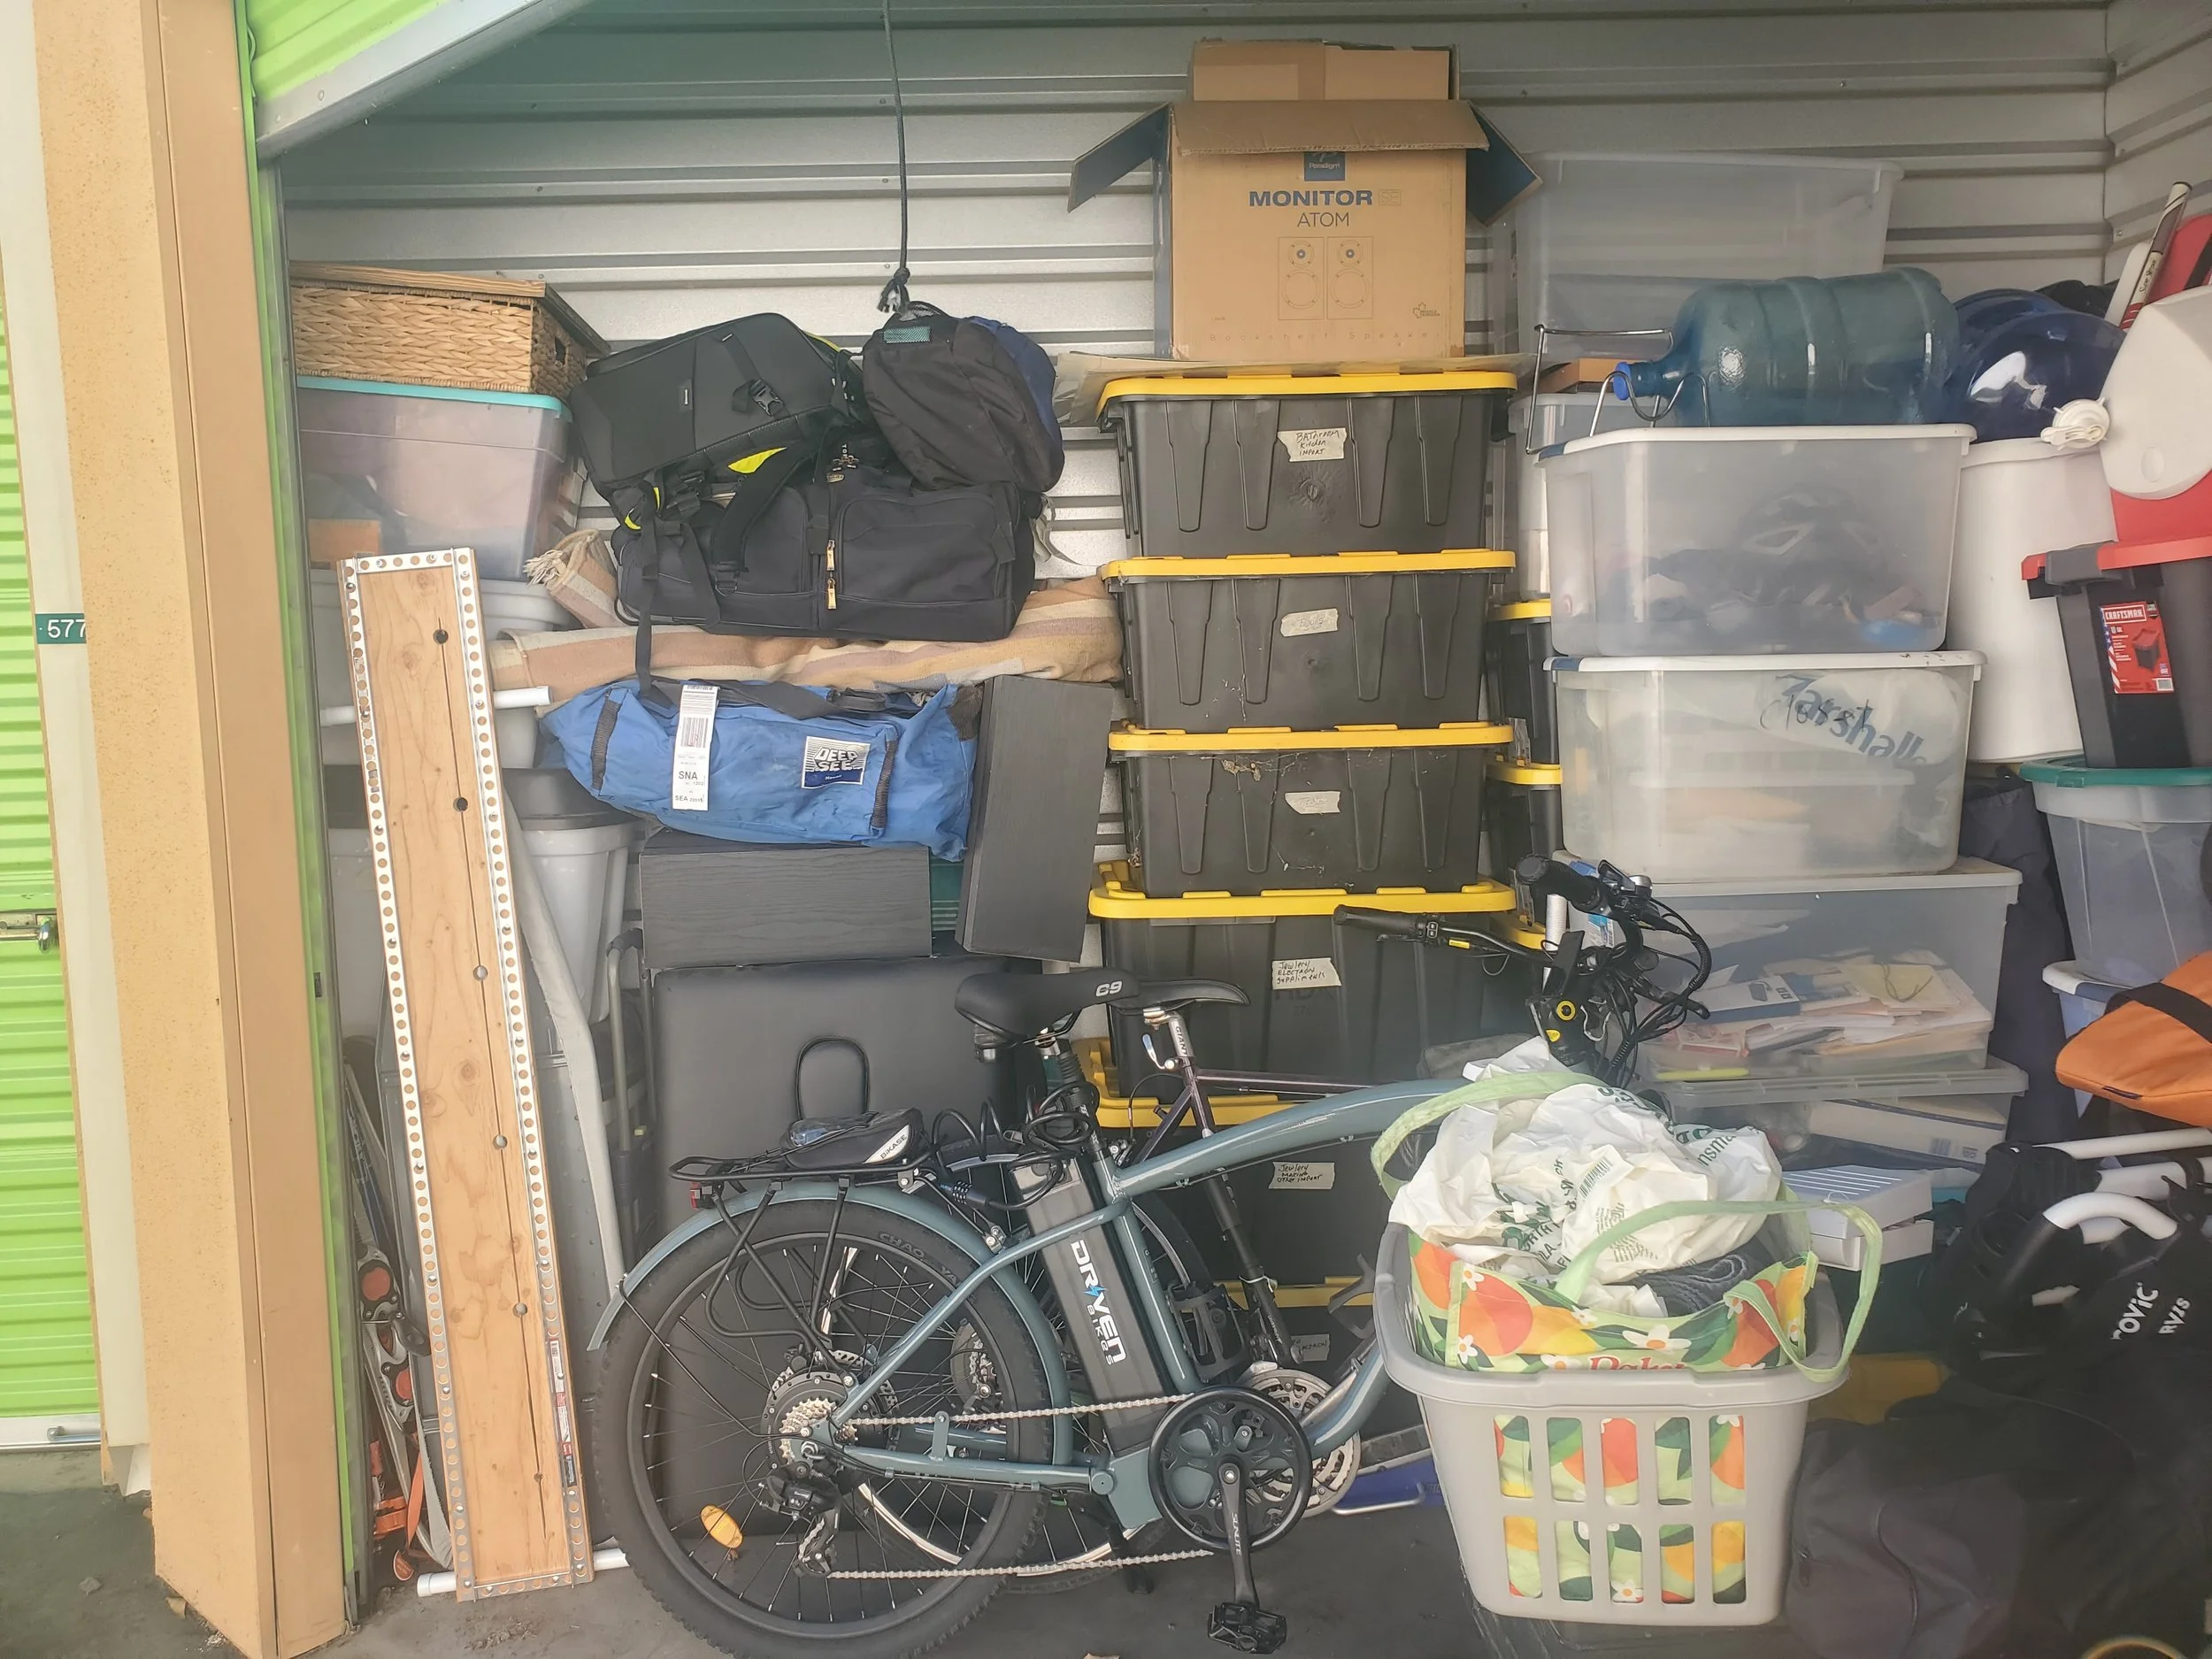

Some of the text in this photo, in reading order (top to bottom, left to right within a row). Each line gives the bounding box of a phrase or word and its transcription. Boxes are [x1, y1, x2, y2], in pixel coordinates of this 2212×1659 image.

[1249, 190, 1373, 206] MONITOR
[1297, 211, 1349, 227] ATOM
[2105, 609, 2143, 620] CRAFTSMAN
[48, 618, 86, 638] 577
[814, 747, 858, 762] DEEP
[818, 760, 853, 772] SEE
[879, 1233, 925, 1257] CHAO
[1232, 1512, 1242, 1556] SUNLITE
